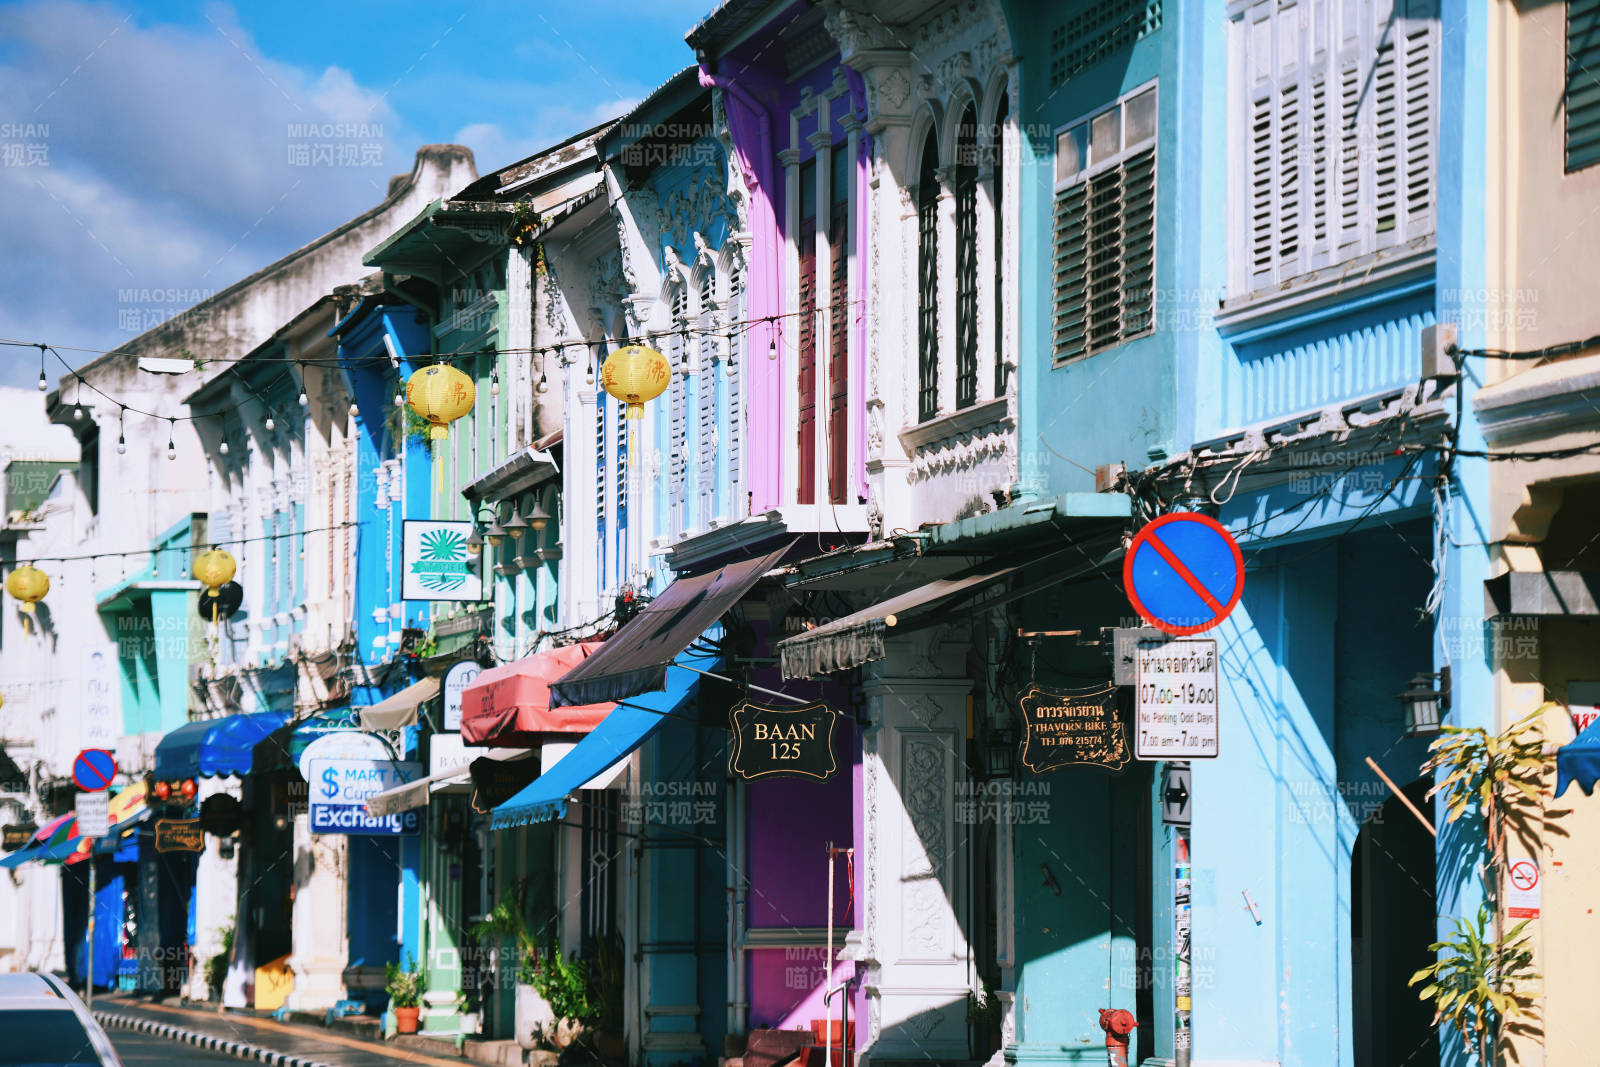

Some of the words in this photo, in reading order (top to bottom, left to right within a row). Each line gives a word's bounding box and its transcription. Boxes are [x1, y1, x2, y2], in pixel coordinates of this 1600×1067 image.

[1141, 712, 1150, 723] No
[1153, 712, 1177, 725] Parking
[1180, 712, 1194, 723] Odd
[1197, 712, 1214, 725] Days
[753, 722, 816, 740] BAAN
[1034, 722, 1082, 733] THAVORN
[1084, 721, 1108, 731] BIKE
[1076, 736, 1103, 745] 215774
[1142, 730, 1159, 747] 7.00
[1181, 730, 1199, 747] 7.00
[1202, 736, 1215, 749] pm
[770, 742, 801, 760] 125
[343, 786, 385, 801] Curr
[314, 805, 417, 833] Exchange
